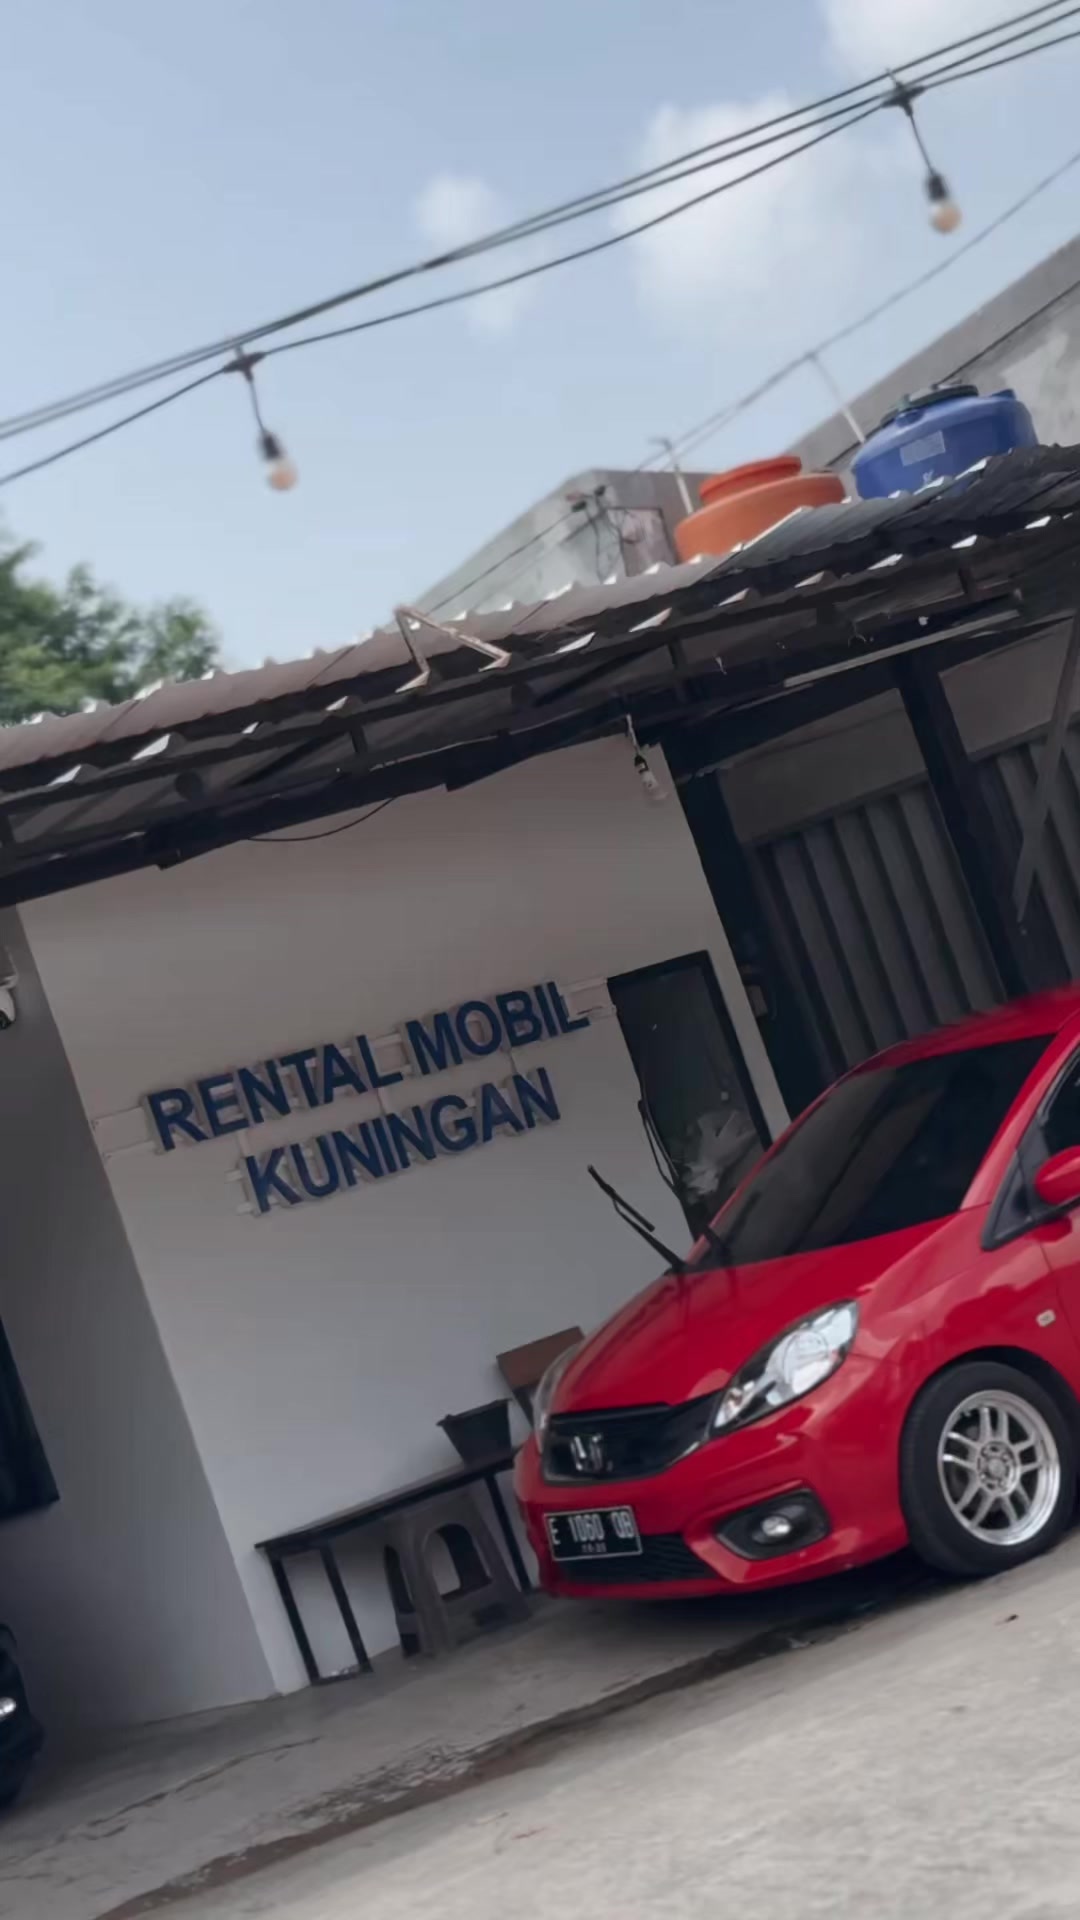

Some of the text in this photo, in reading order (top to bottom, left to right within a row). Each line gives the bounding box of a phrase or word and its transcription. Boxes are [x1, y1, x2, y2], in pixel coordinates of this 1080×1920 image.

[147, 981, 591, 1152] RENTAL MOBIL
[245, 1067, 561, 1213] KUNINGAN
[550, 1518, 561, 1545] E
